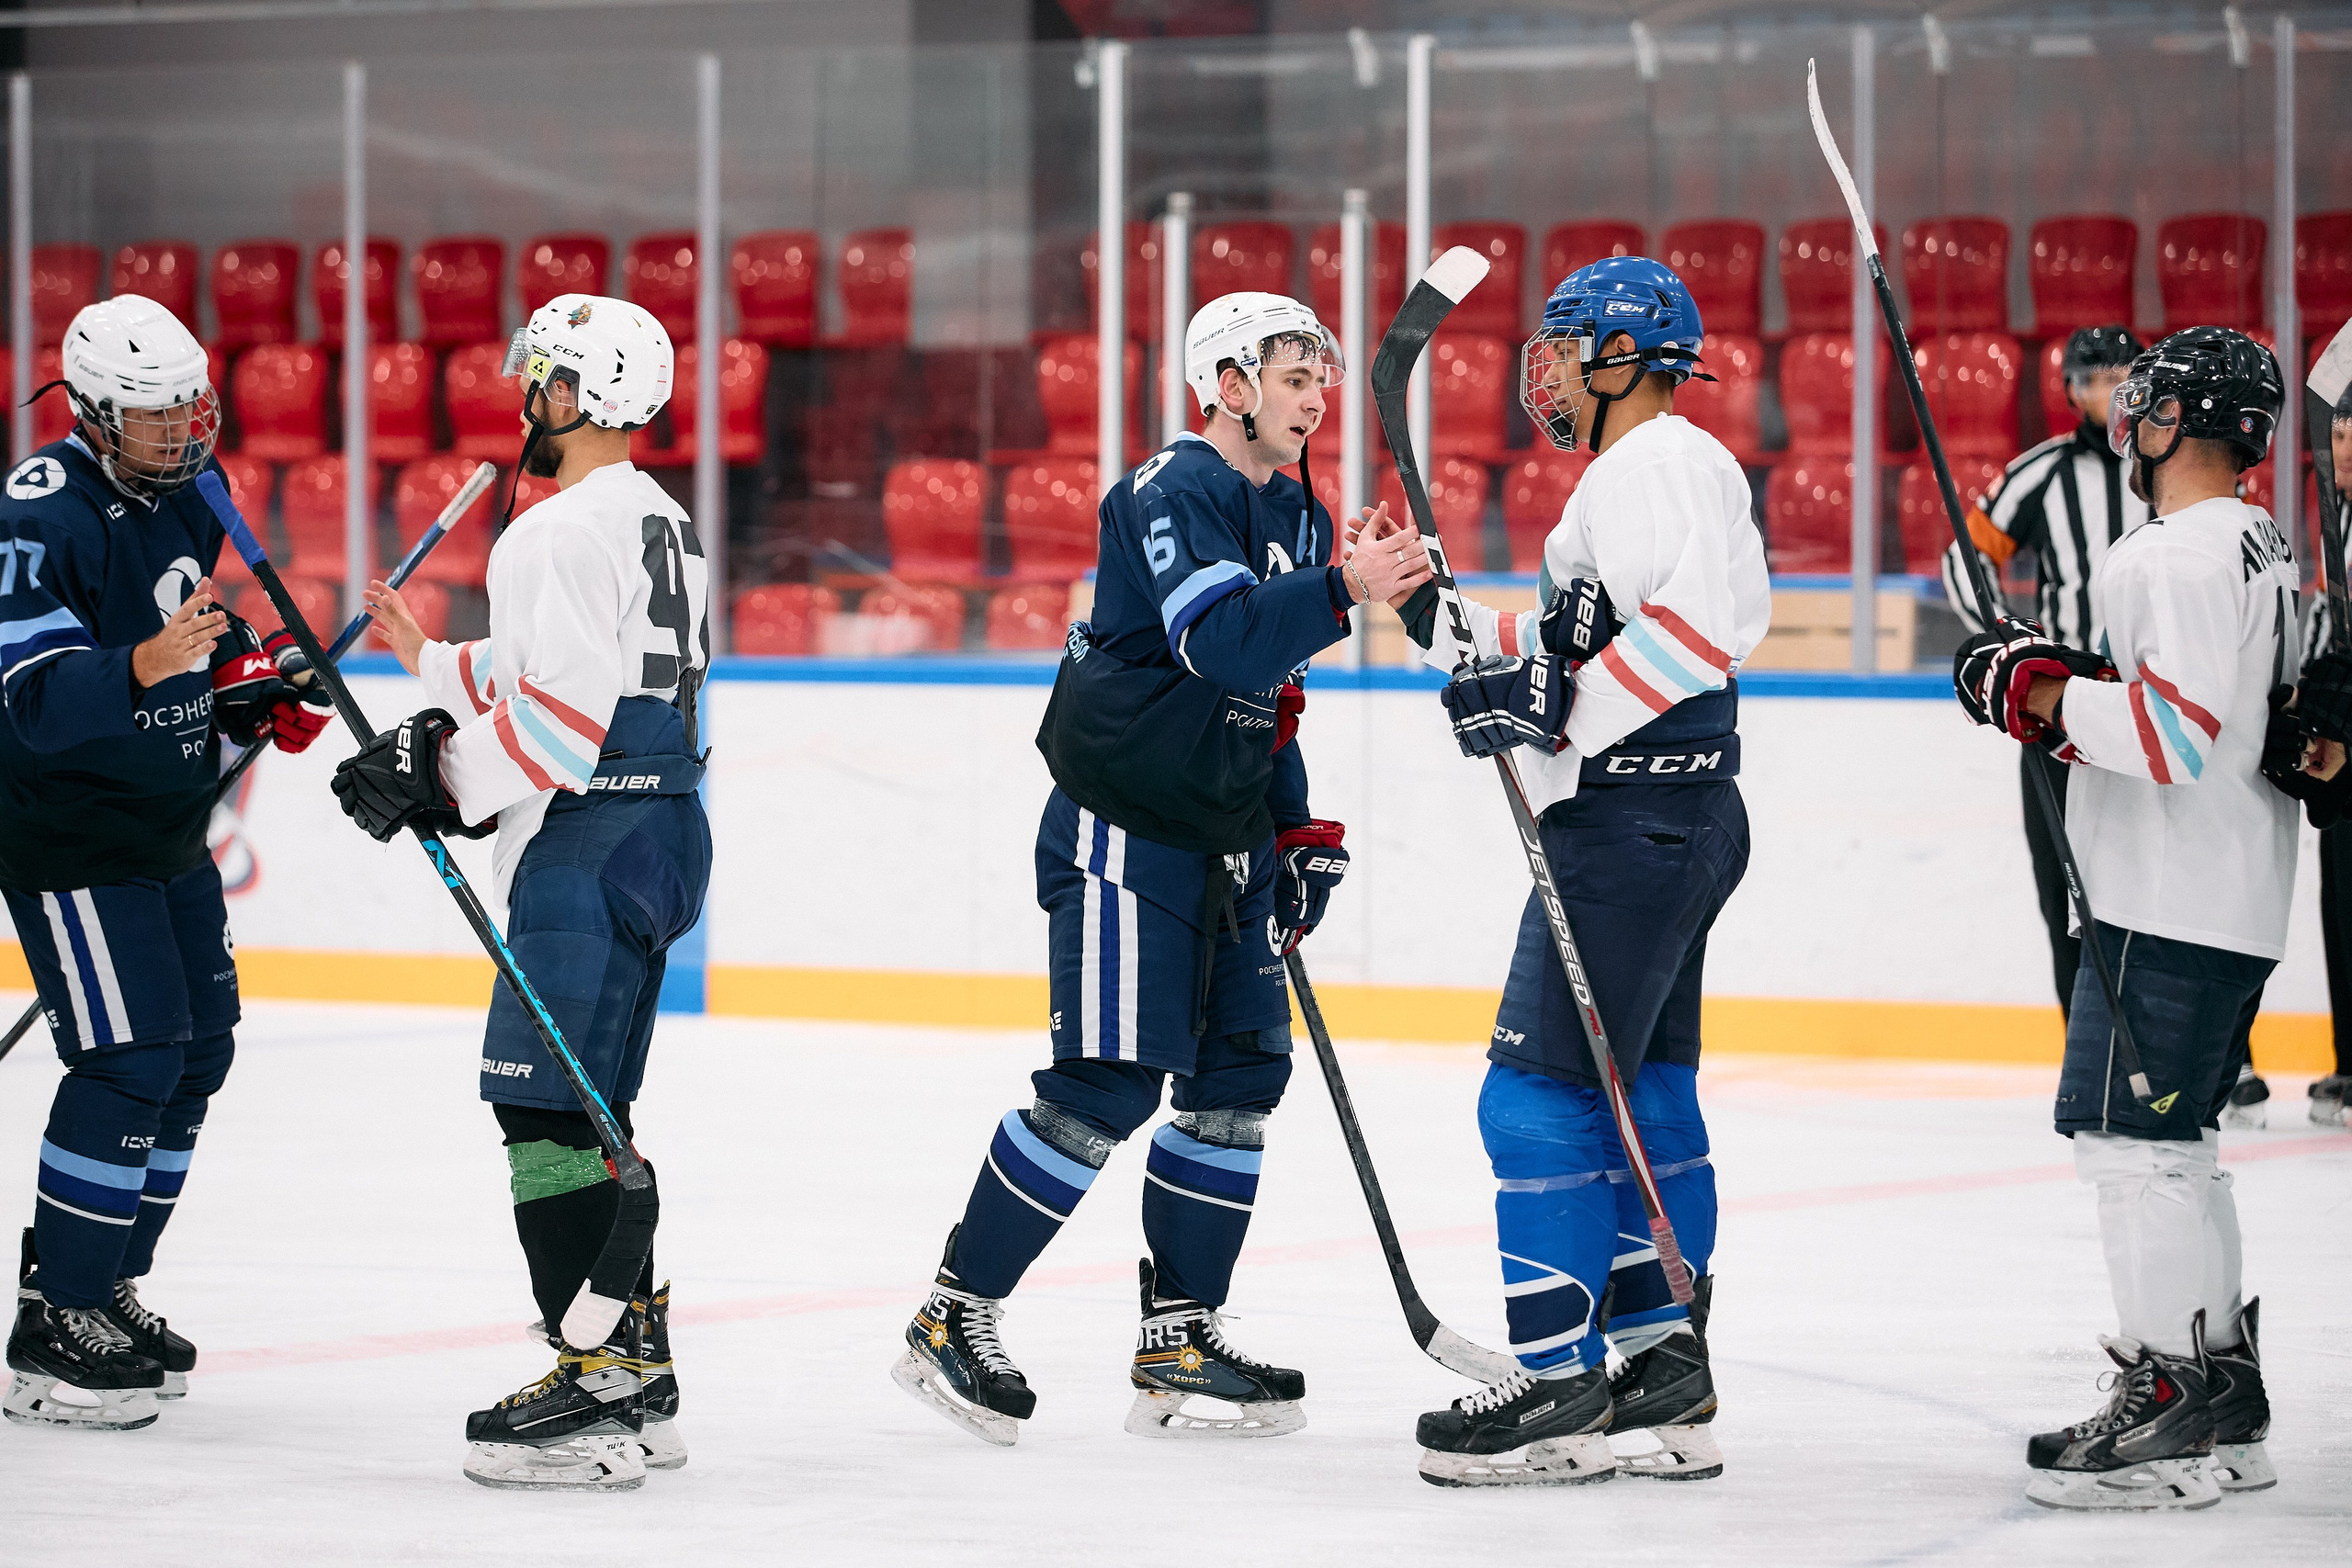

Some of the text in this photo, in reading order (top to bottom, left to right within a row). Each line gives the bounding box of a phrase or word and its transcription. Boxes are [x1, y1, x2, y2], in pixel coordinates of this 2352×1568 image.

[1606, 302, 1646, 314] CCM
[1193, 327, 1226, 350] BAUER
[552, 344, 585, 360] CCM
[1607, 353, 1641, 365] BAUER
[1529, 652, 1551, 716] UER
[1606, 750, 1723, 774] CCM
[588, 774, 662, 790] AUER
[1493, 1023, 1526, 1046] CM
[481, 1057, 534, 1079] AUER
[1166, 1373, 1212, 1385] «ХОРС»
